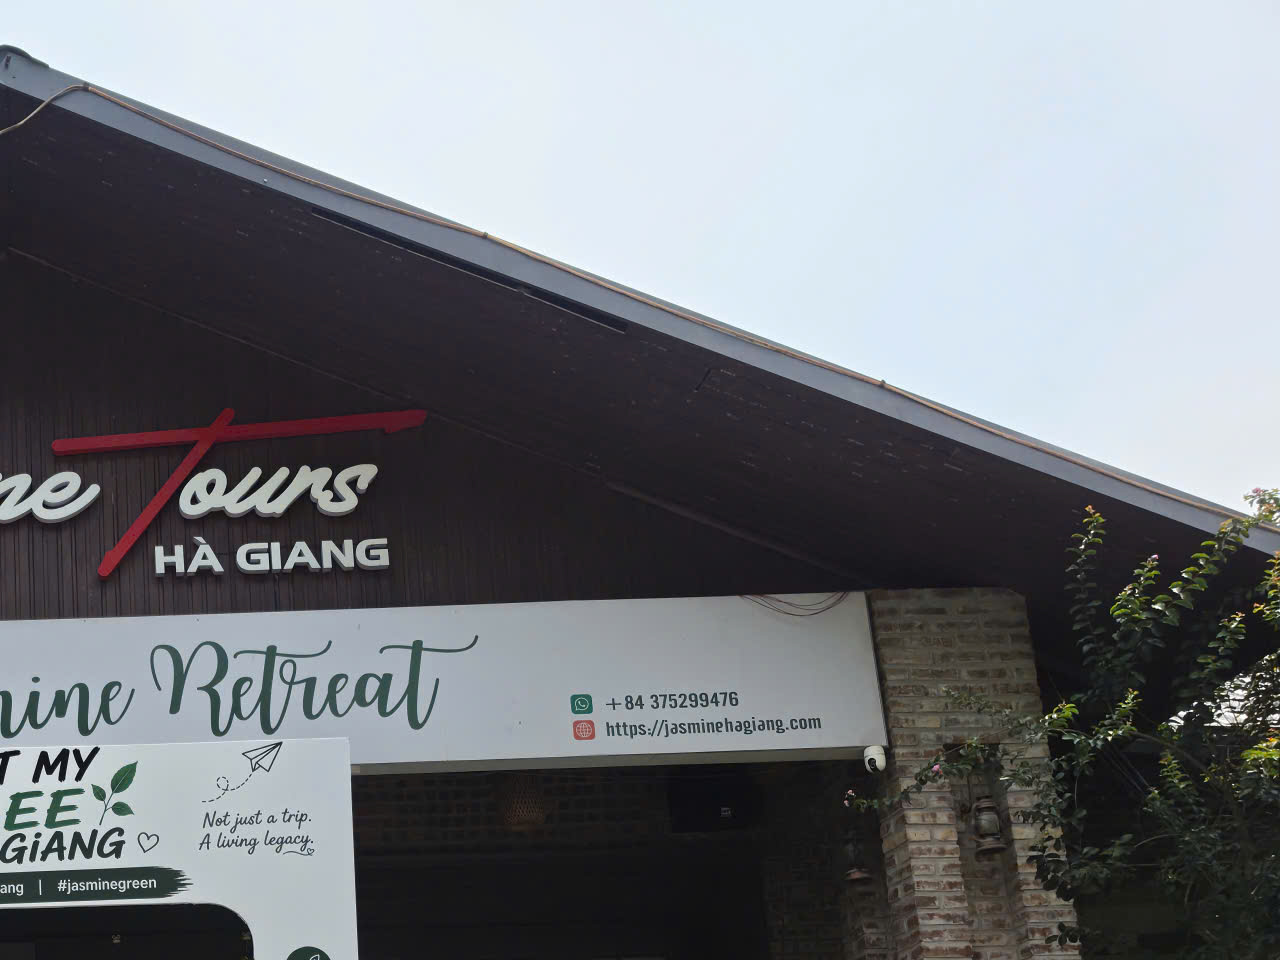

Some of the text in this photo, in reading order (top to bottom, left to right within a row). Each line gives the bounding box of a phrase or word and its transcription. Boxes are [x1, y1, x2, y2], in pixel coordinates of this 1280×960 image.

[51, 407, 428, 579] Tours
[154, 535, 392, 577] HÀ GIANG
[149, 634, 480, 737] Retreat
[650, 691, 739, 710] 375299476
[605, 716, 822, 740] https://jasminehagiang.com
[31, 746, 100, 785] MY
[202, 808, 312, 834] Not just a trip.
[198, 830, 314, 855] A living legacy.
[57, 876, 158, 895] #jasminegreen
